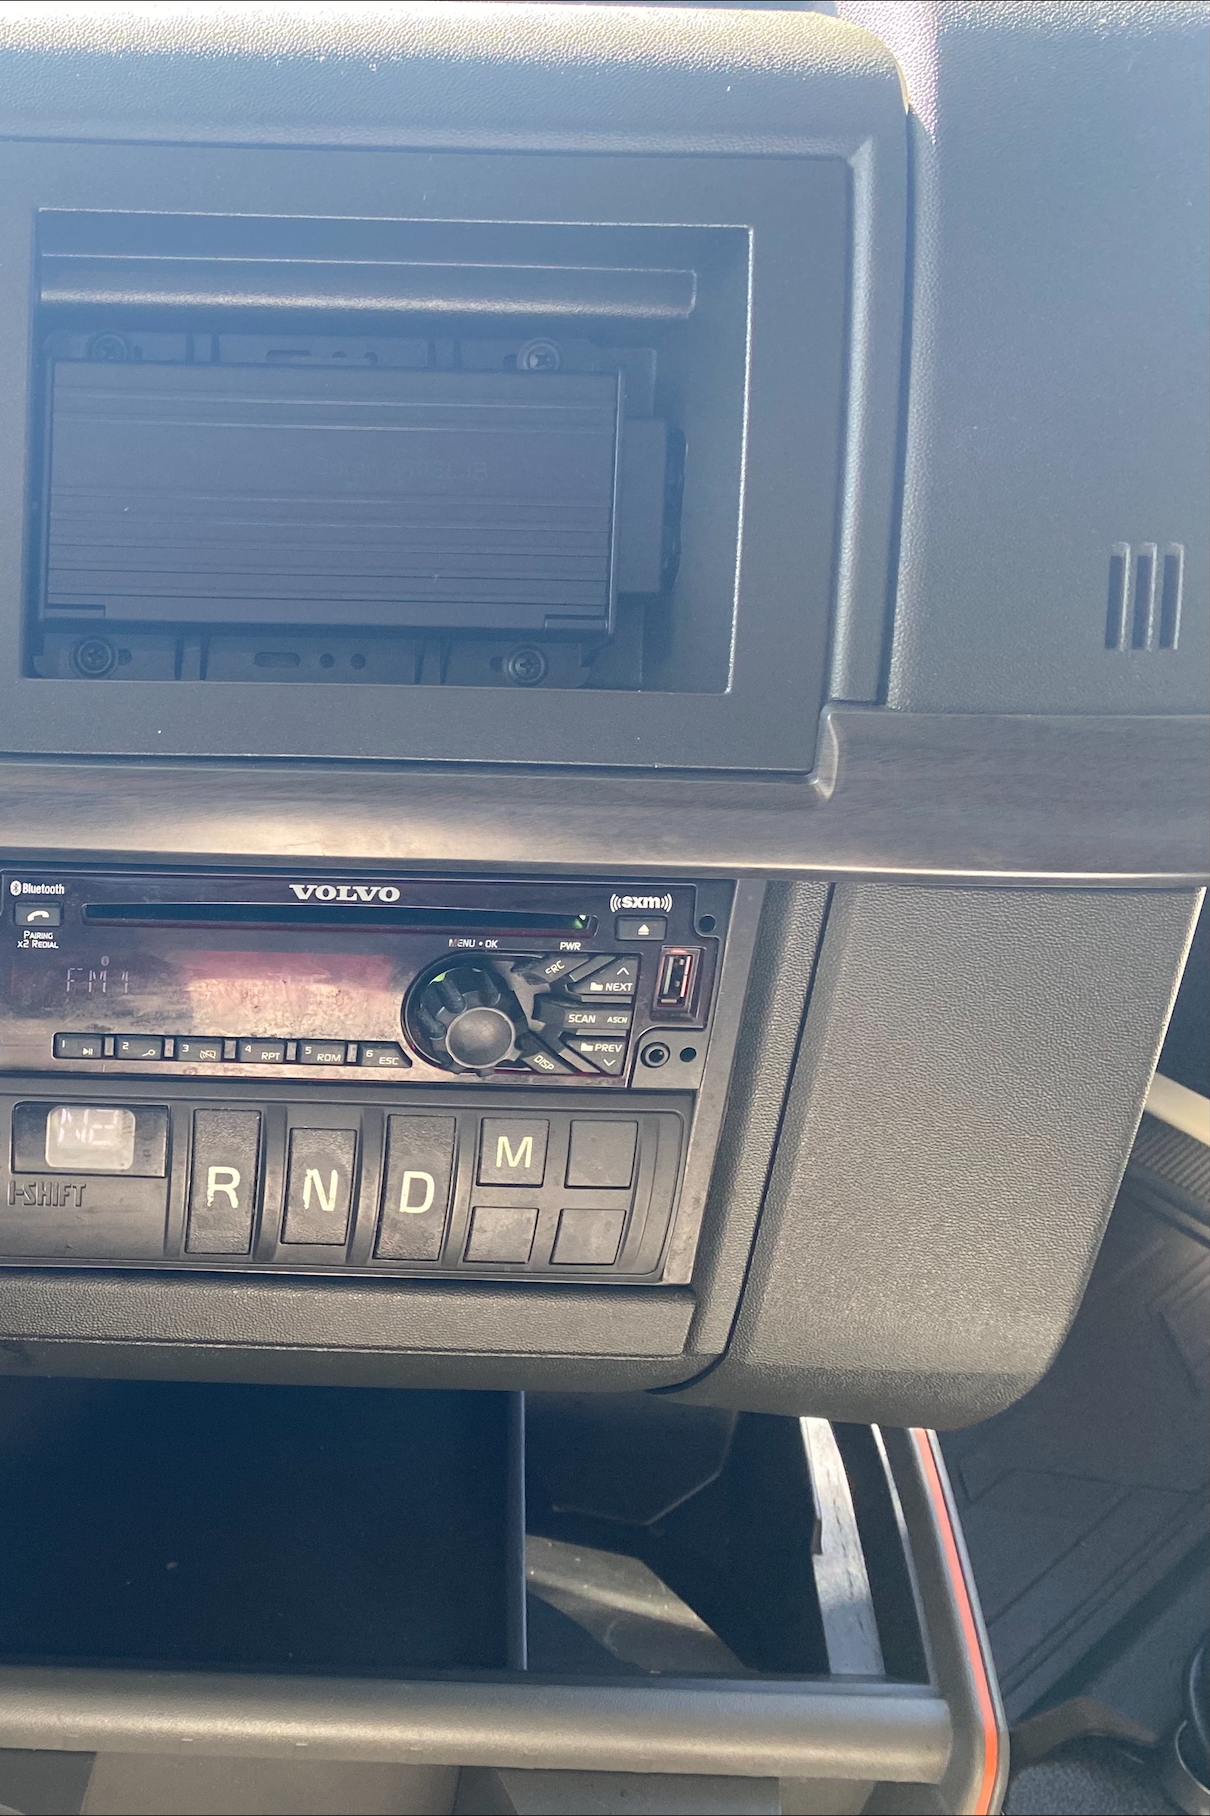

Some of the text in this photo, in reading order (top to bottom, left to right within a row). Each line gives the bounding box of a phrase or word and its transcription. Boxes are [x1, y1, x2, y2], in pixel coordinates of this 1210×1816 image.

[22, 883, 65, 895] Bluetooth
[289, 884, 401, 902] VOLVO
[448, 938, 499, 949] MENU OK
[559, 941, 582, 951] PWR
[605, 982, 634, 993] NEXT
[568, 1014, 628, 1024] SCAN ASCN
[122, 1041, 130, 1050] 2
[182, 1044, 190, 1053] 3
[244, 1044, 252, 1053] 4
[304, 1046, 312, 1055] 5
[594, 1043, 623, 1053] PREV
[261, 1051, 281, 1061] RPT
[316, 1053, 342, 1063] RDM
[365, 1049, 374, 1058] 6
[378, 1056, 399, 1066] ESC
[533, 1054, 555, 1071] DISP
[495, 1135, 533, 1168] M
[207, 1166, 240, 1209] R
[303, 1168, 338, 1212] N
[399, 1170, 435, 1214] D
[8, 1180, 86, 1207] I-SHIFT
